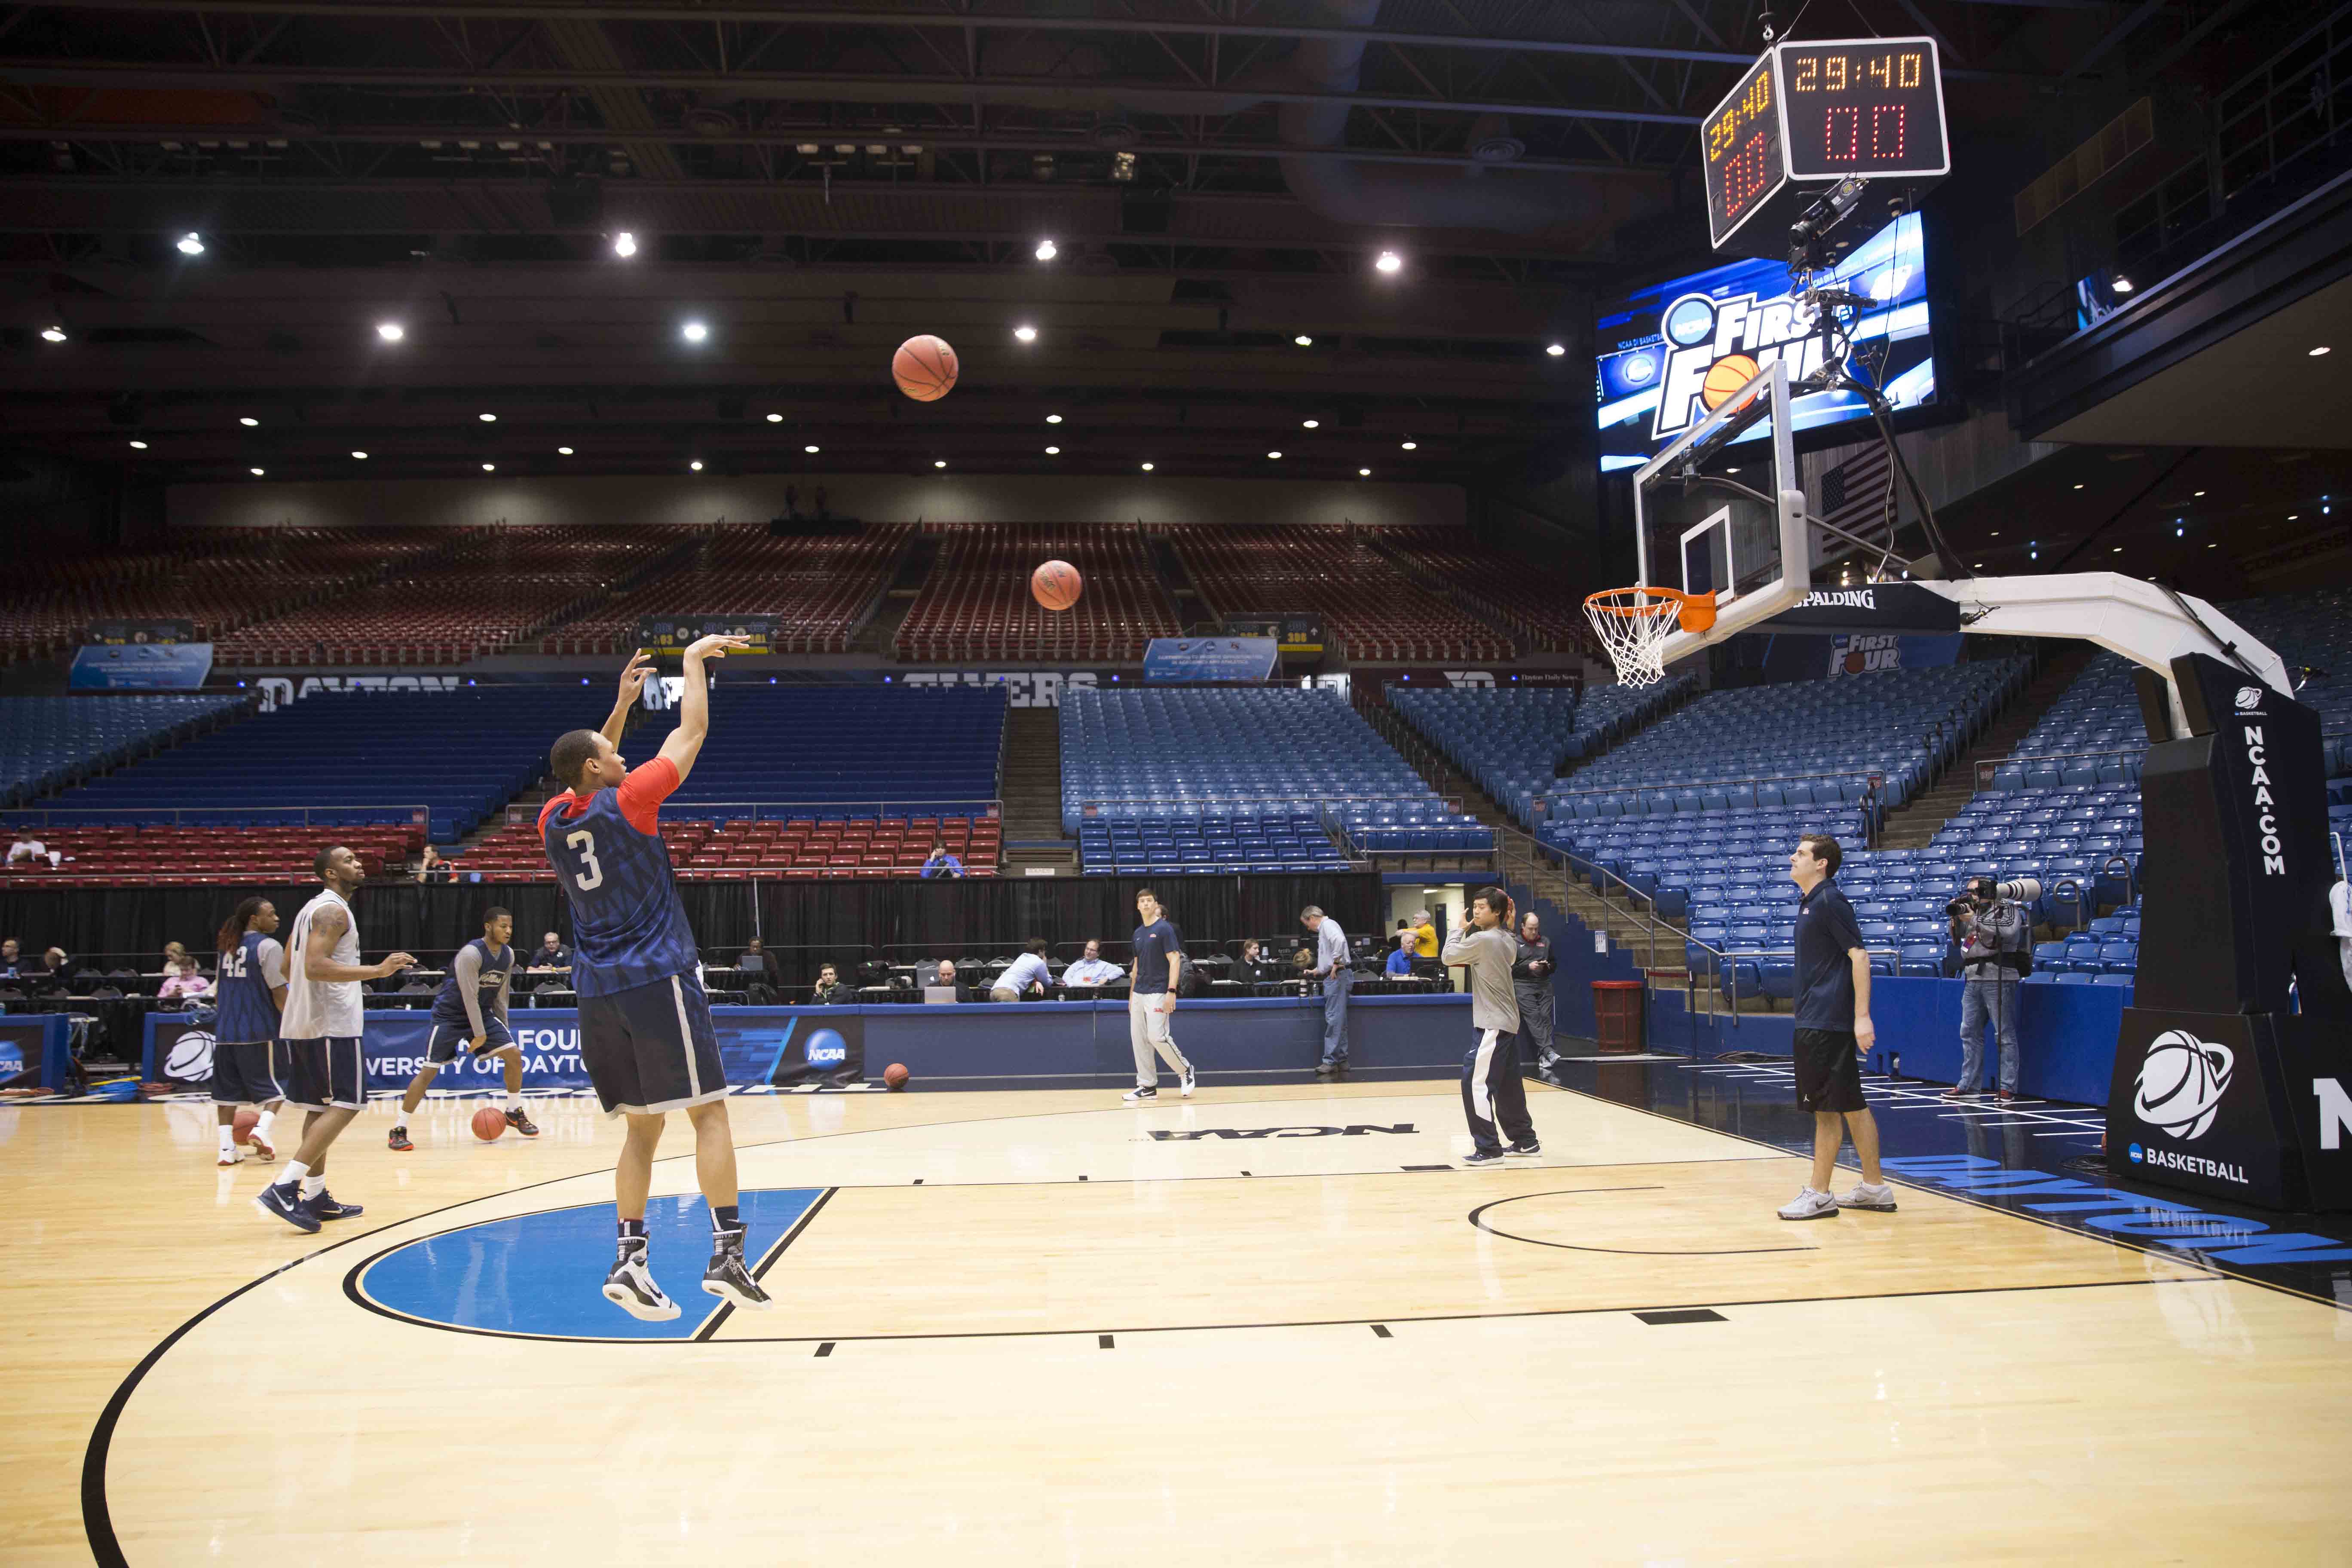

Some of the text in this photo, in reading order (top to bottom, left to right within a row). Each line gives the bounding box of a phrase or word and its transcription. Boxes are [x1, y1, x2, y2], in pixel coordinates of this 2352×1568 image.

[1796, 53, 1921, 92] 29:40
[1709, 70, 1769, 162] 29:40
[1826, 104, 1905, 161] 00
[1639, 333, 1663, 345] BASKETB
[1849, 634, 1899, 652] FIRST
[2244, 726, 2286, 875] NCAA.COM
[566, 830, 603, 891] 3
[222, 946, 247, 977] 42
[518, 1029, 581, 1051] FOU
[0, 1060, 23, 1072] CAA
[521, 1055, 588, 1073] DAYT
[808, 1048, 845, 1060] NCAA
[2130, 1151, 2143, 1160] NCAA
[2147, 1148, 2249, 1183] BASKETBALL
